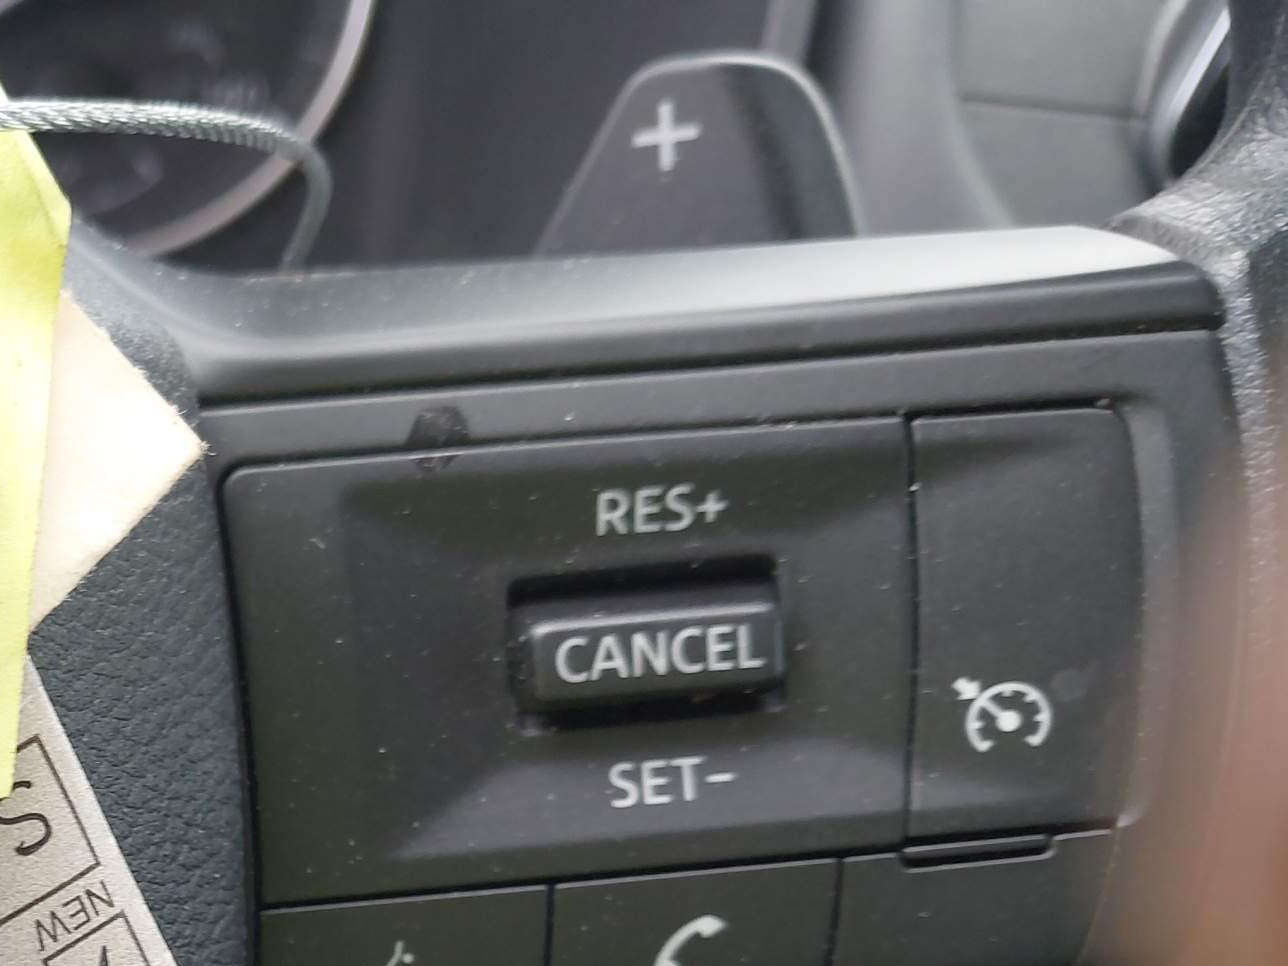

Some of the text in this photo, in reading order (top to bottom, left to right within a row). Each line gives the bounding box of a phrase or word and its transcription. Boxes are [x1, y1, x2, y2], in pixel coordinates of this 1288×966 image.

[596, 483, 730, 537] RES+
[555, 622, 768, 683] CANCEL
[609, 755, 740, 808] SET-
[35, 880, 116, 951] NEW
